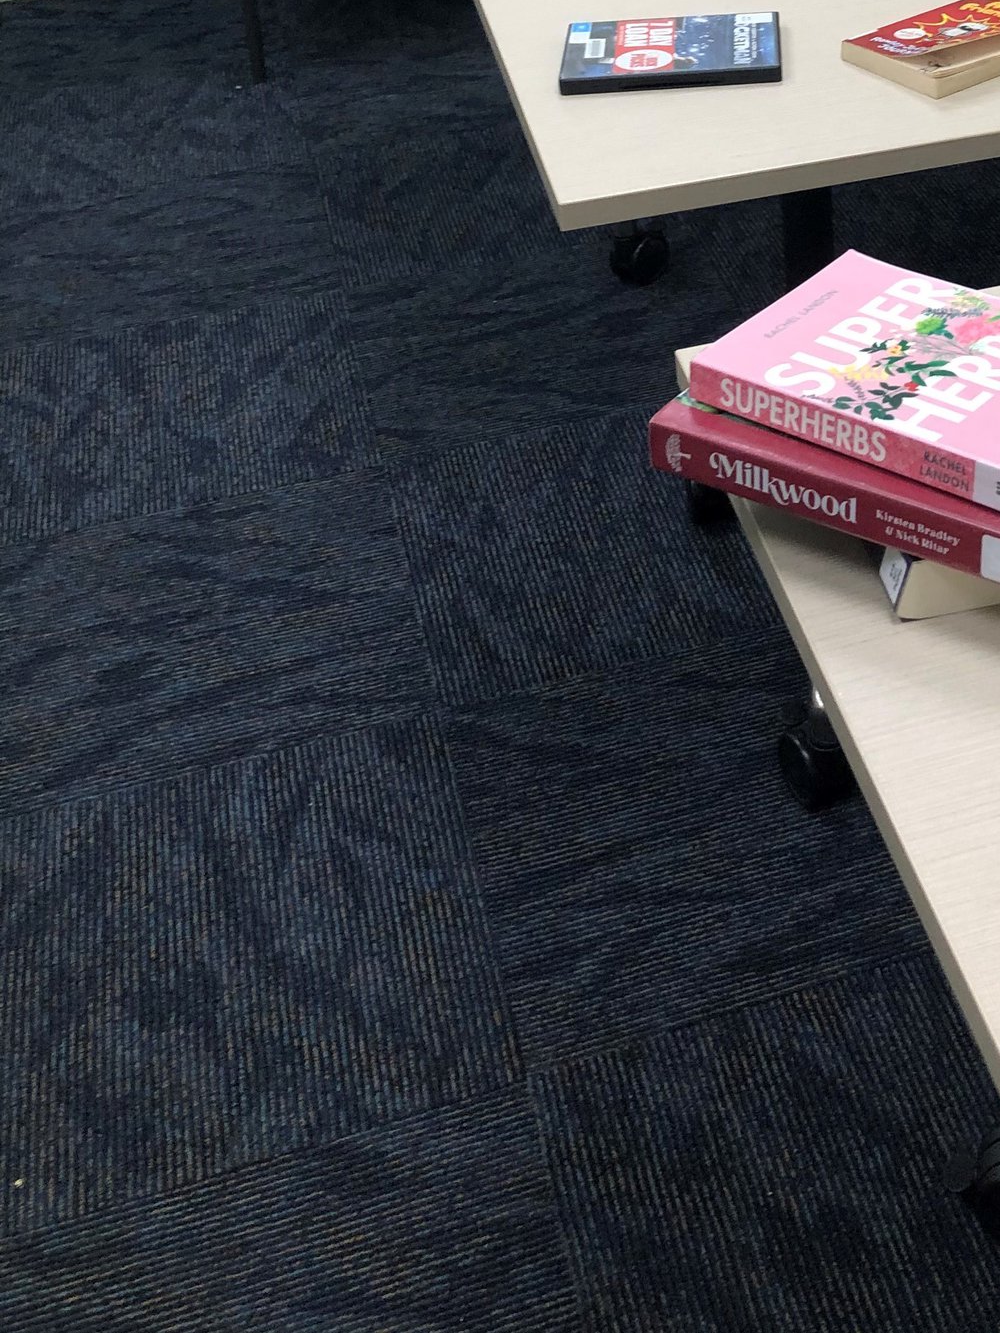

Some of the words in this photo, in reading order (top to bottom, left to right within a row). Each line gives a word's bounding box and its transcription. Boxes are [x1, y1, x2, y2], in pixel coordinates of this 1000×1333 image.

[624, 23, 648, 47] LOAN
[649, 28, 673, 46] DAY
[764, 314, 801, 338] RACHEL
[802, 289, 839, 316] LANDON
[764, 277, 952, 396] SUPER
[720, 378, 887, 462] SUPERHERBS
[923, 451, 967, 476] RACHEL
[709, 451, 857, 524] Milkwood
[920, 465, 969, 492] LANDON
[895, 529, 921, 546] Nick
[917, 522, 961, 547] Bradley
